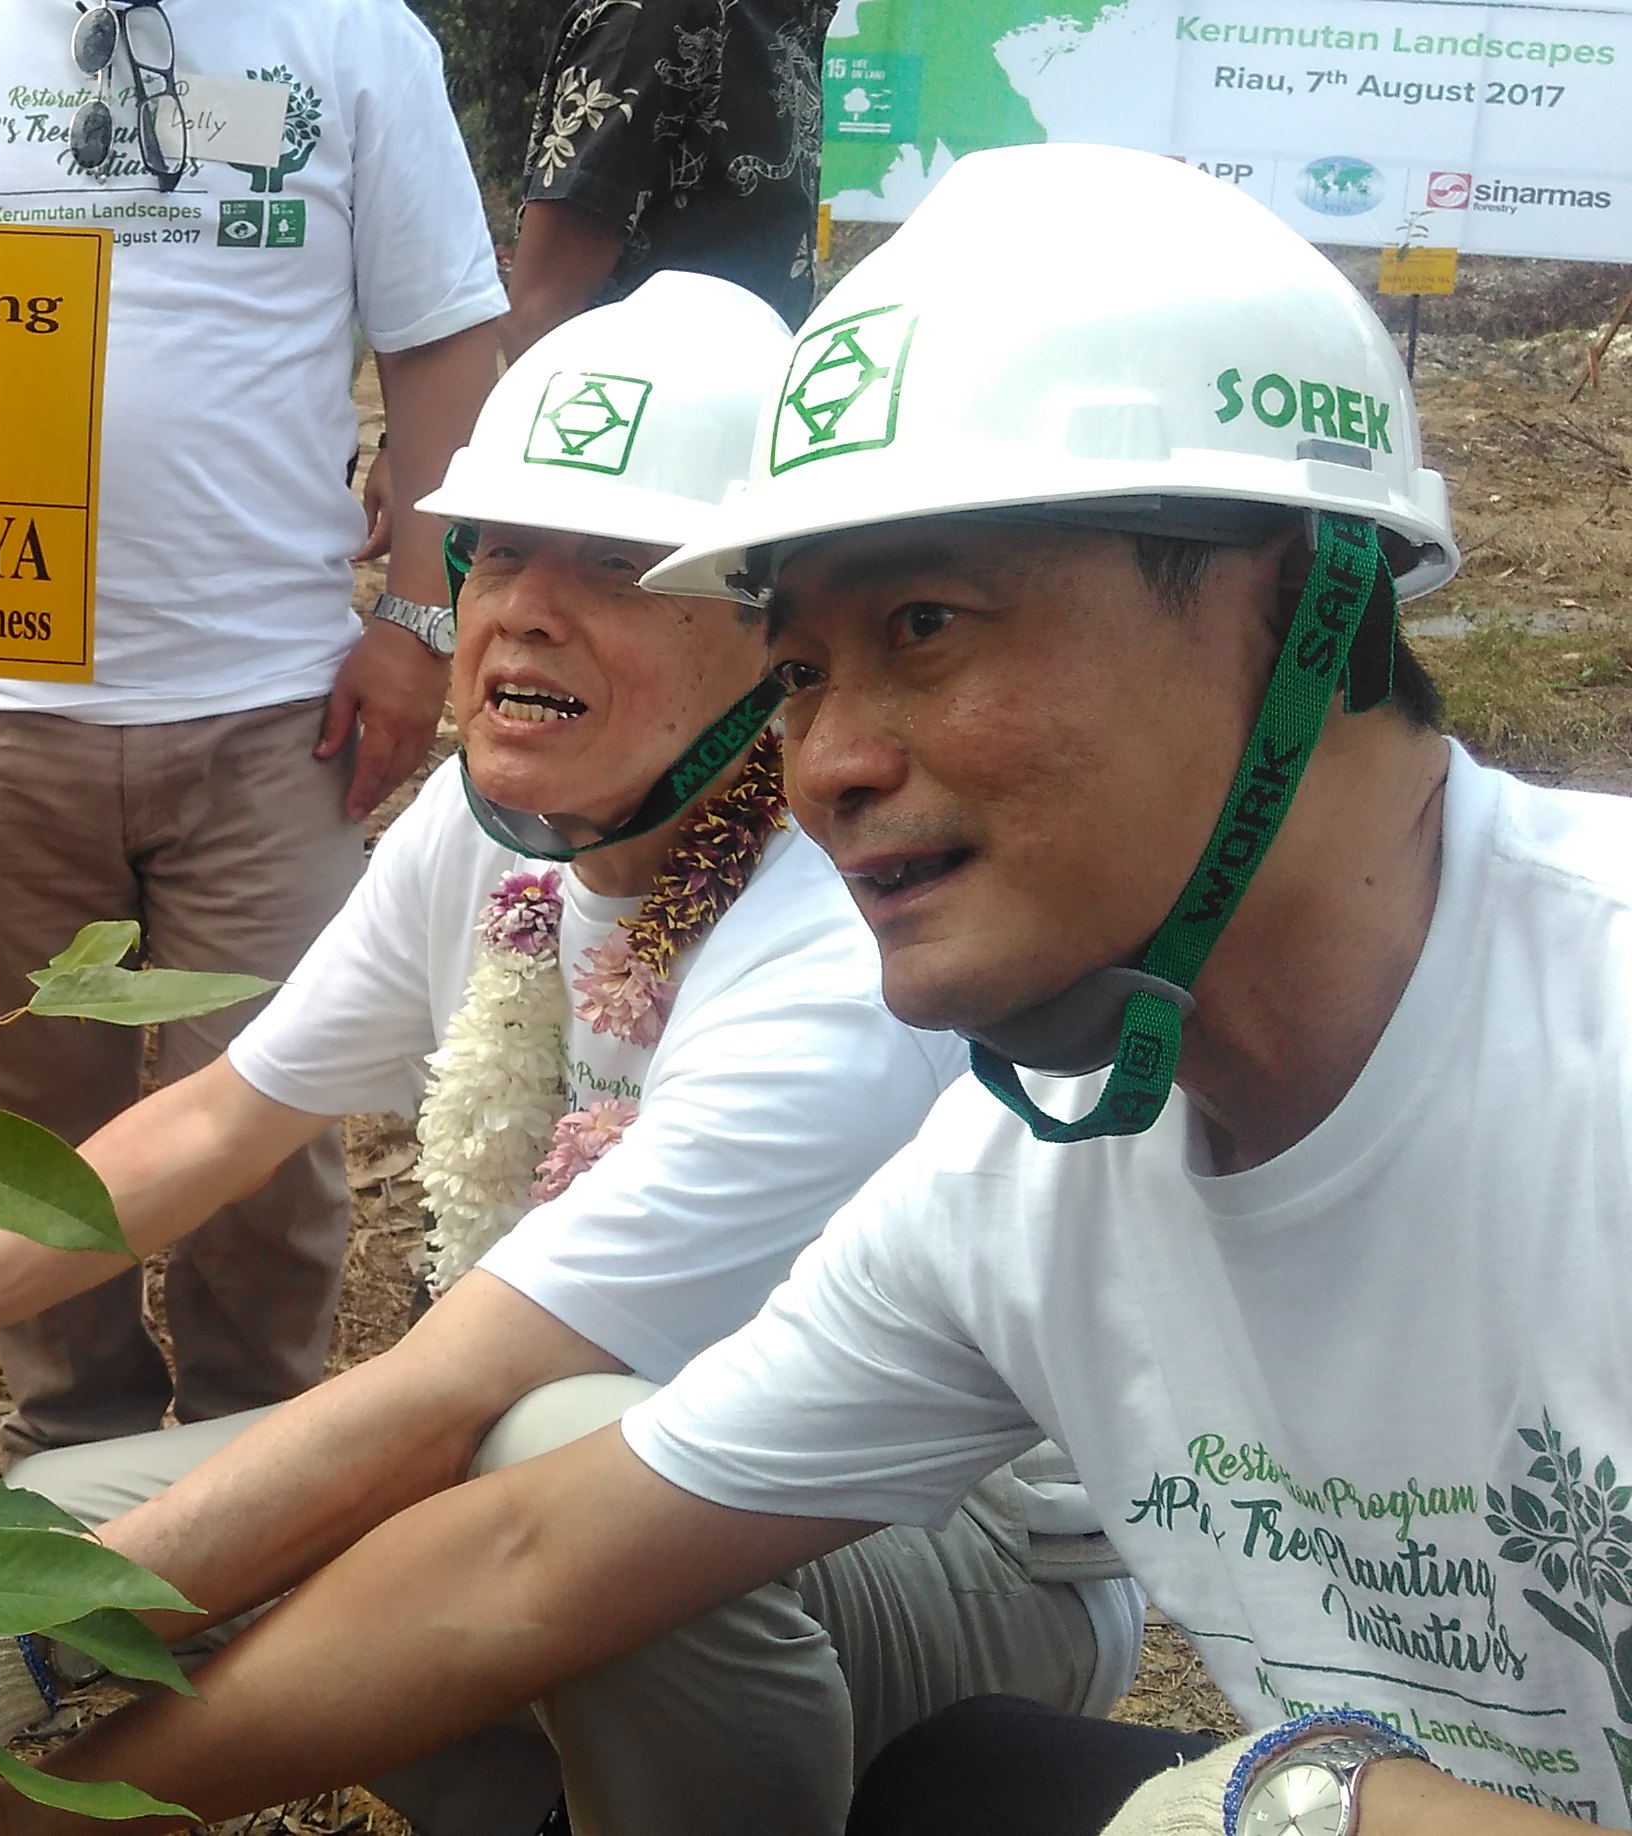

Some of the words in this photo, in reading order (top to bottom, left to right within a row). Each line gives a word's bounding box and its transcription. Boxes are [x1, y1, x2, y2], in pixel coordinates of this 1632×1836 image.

[1175, 16, 1378, 51] Kerumutan
[1393, 27, 1615, 68] Landscapes
[828, 58, 846, 79] 15
[1214, 66, 1294, 95] Riau,
[1306, 69, 1348, 94] 7th
[1356, 74, 1476, 105] August
[1484, 82, 1566, 108] 2017
[92, 202, 202, 221] Landscapes
[1473, 202, 1518, 215] forestry
[1474, 180, 1612, 208] sinarmas
[112, 231, 157, 247] ugust
[162, 229, 201, 244] 2017
[1215, 367, 1394, 454] SOREK
[1181, 736, 1304, 924] WORK
[576, 1061, 642, 1100] Progra
[1322, 1476, 1479, 1543] Program
[1313, 1527, 1497, 1631] Planting
[1321, 1583, 1528, 1681] Initiatives
